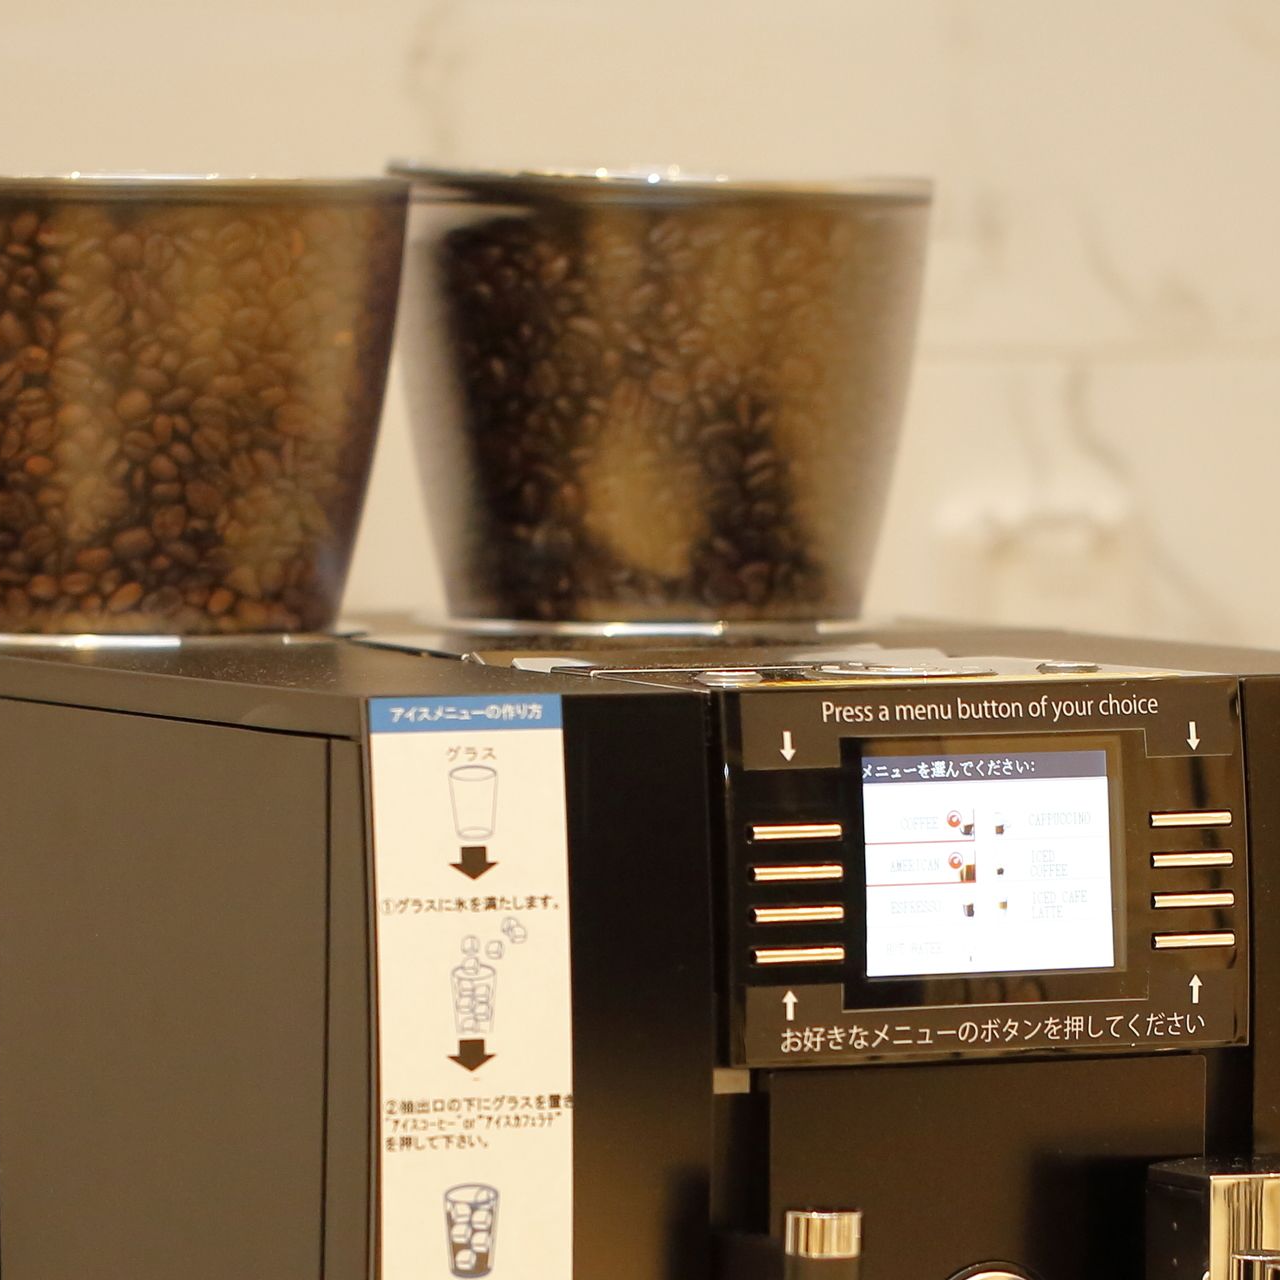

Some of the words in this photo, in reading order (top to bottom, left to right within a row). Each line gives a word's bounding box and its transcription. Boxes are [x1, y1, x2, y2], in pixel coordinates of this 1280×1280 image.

[390, 703, 543, 723] アイスメニューの作り方
[822, 701, 873, 723] Press
[879, 706, 890, 721] a
[895, 704, 952, 721] menu
[957, 697, 1023, 720] button
[1028, 695, 1049, 717] of
[1052, 700, 1095, 721] your
[1098, 693, 1159, 716] choice
[447, 746, 497, 762] グラス
[781, 1012, 1206, 1053] お好きなメニューのボタンを押してください
